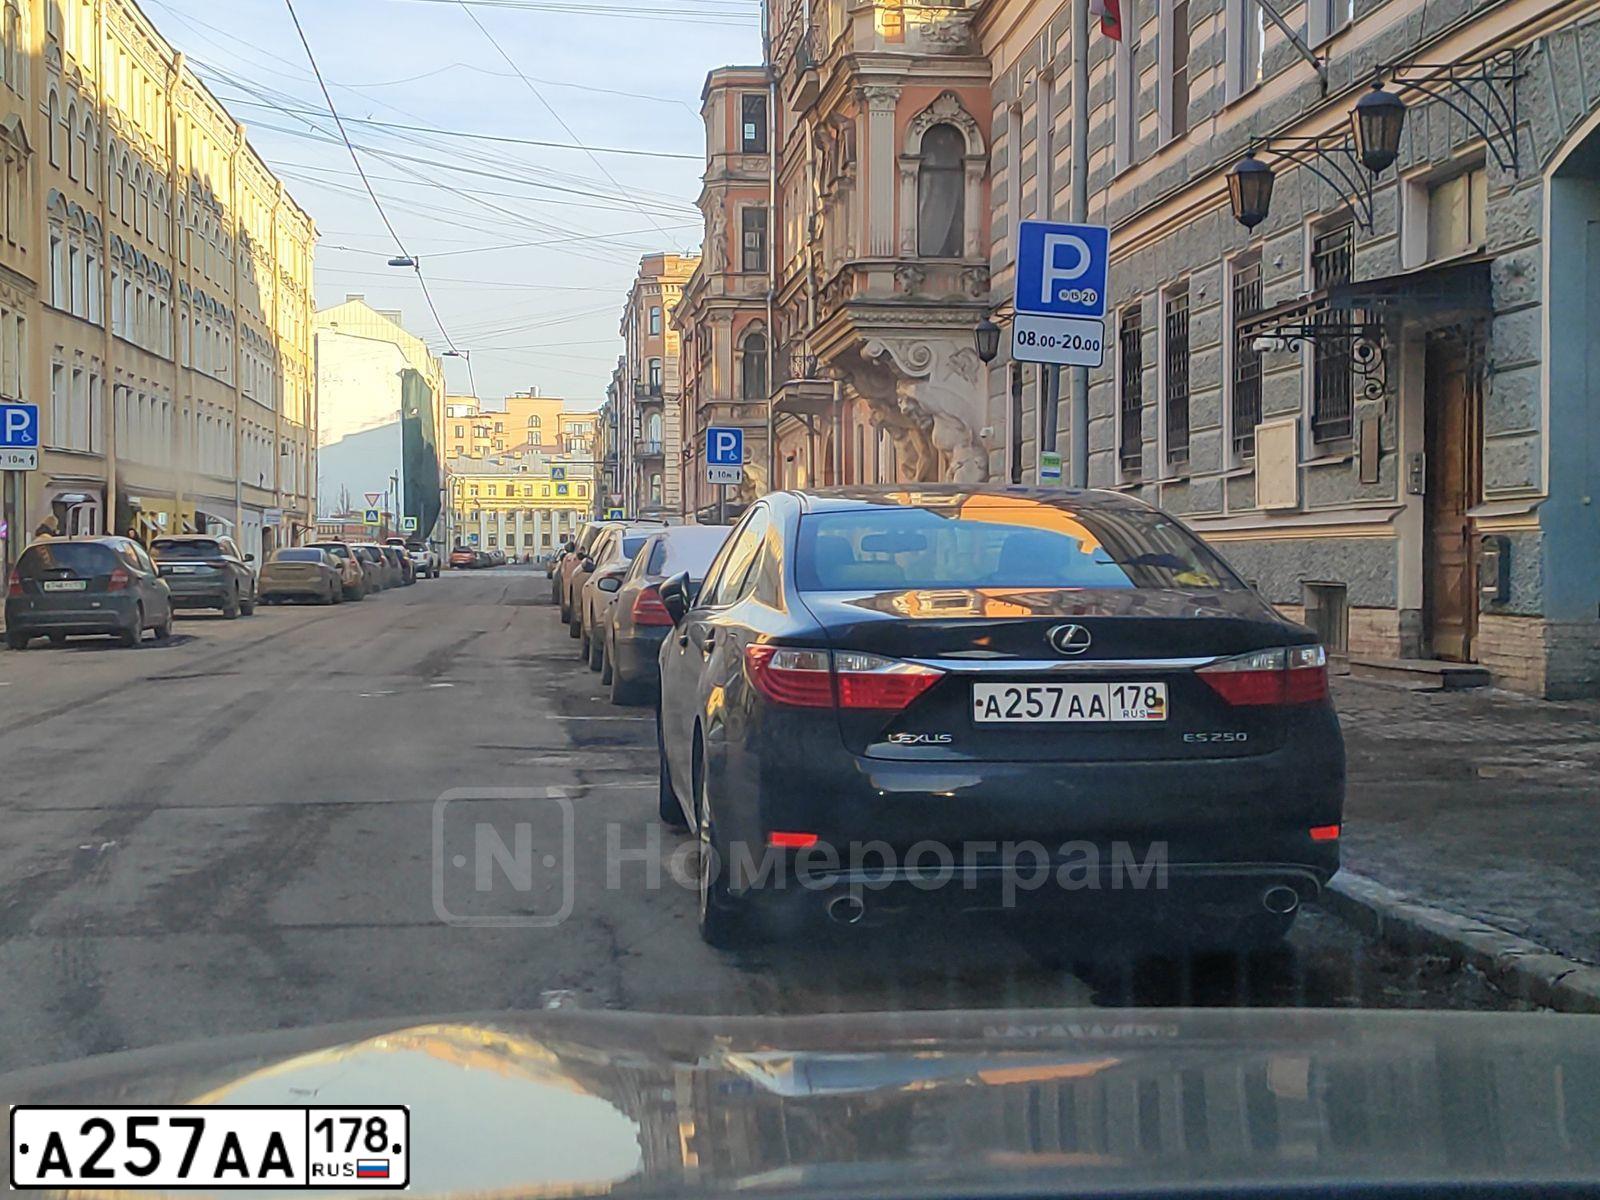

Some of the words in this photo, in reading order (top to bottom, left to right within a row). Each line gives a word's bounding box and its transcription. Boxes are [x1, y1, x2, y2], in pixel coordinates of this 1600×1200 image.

[1041, 233, 1091, 304] P
[1071, 291, 1080, 300] 15
[1082, 291, 1096, 302] 20
[1017, 330, 1100, 352] 08.00-20.00
[6, 408, 30, 442] P
[716, 432, 737, 461] P
[1112, 686, 1157, 709] 178
[1122, 710, 1146, 719] RUS
[887, 733, 953, 744] LEXUS
